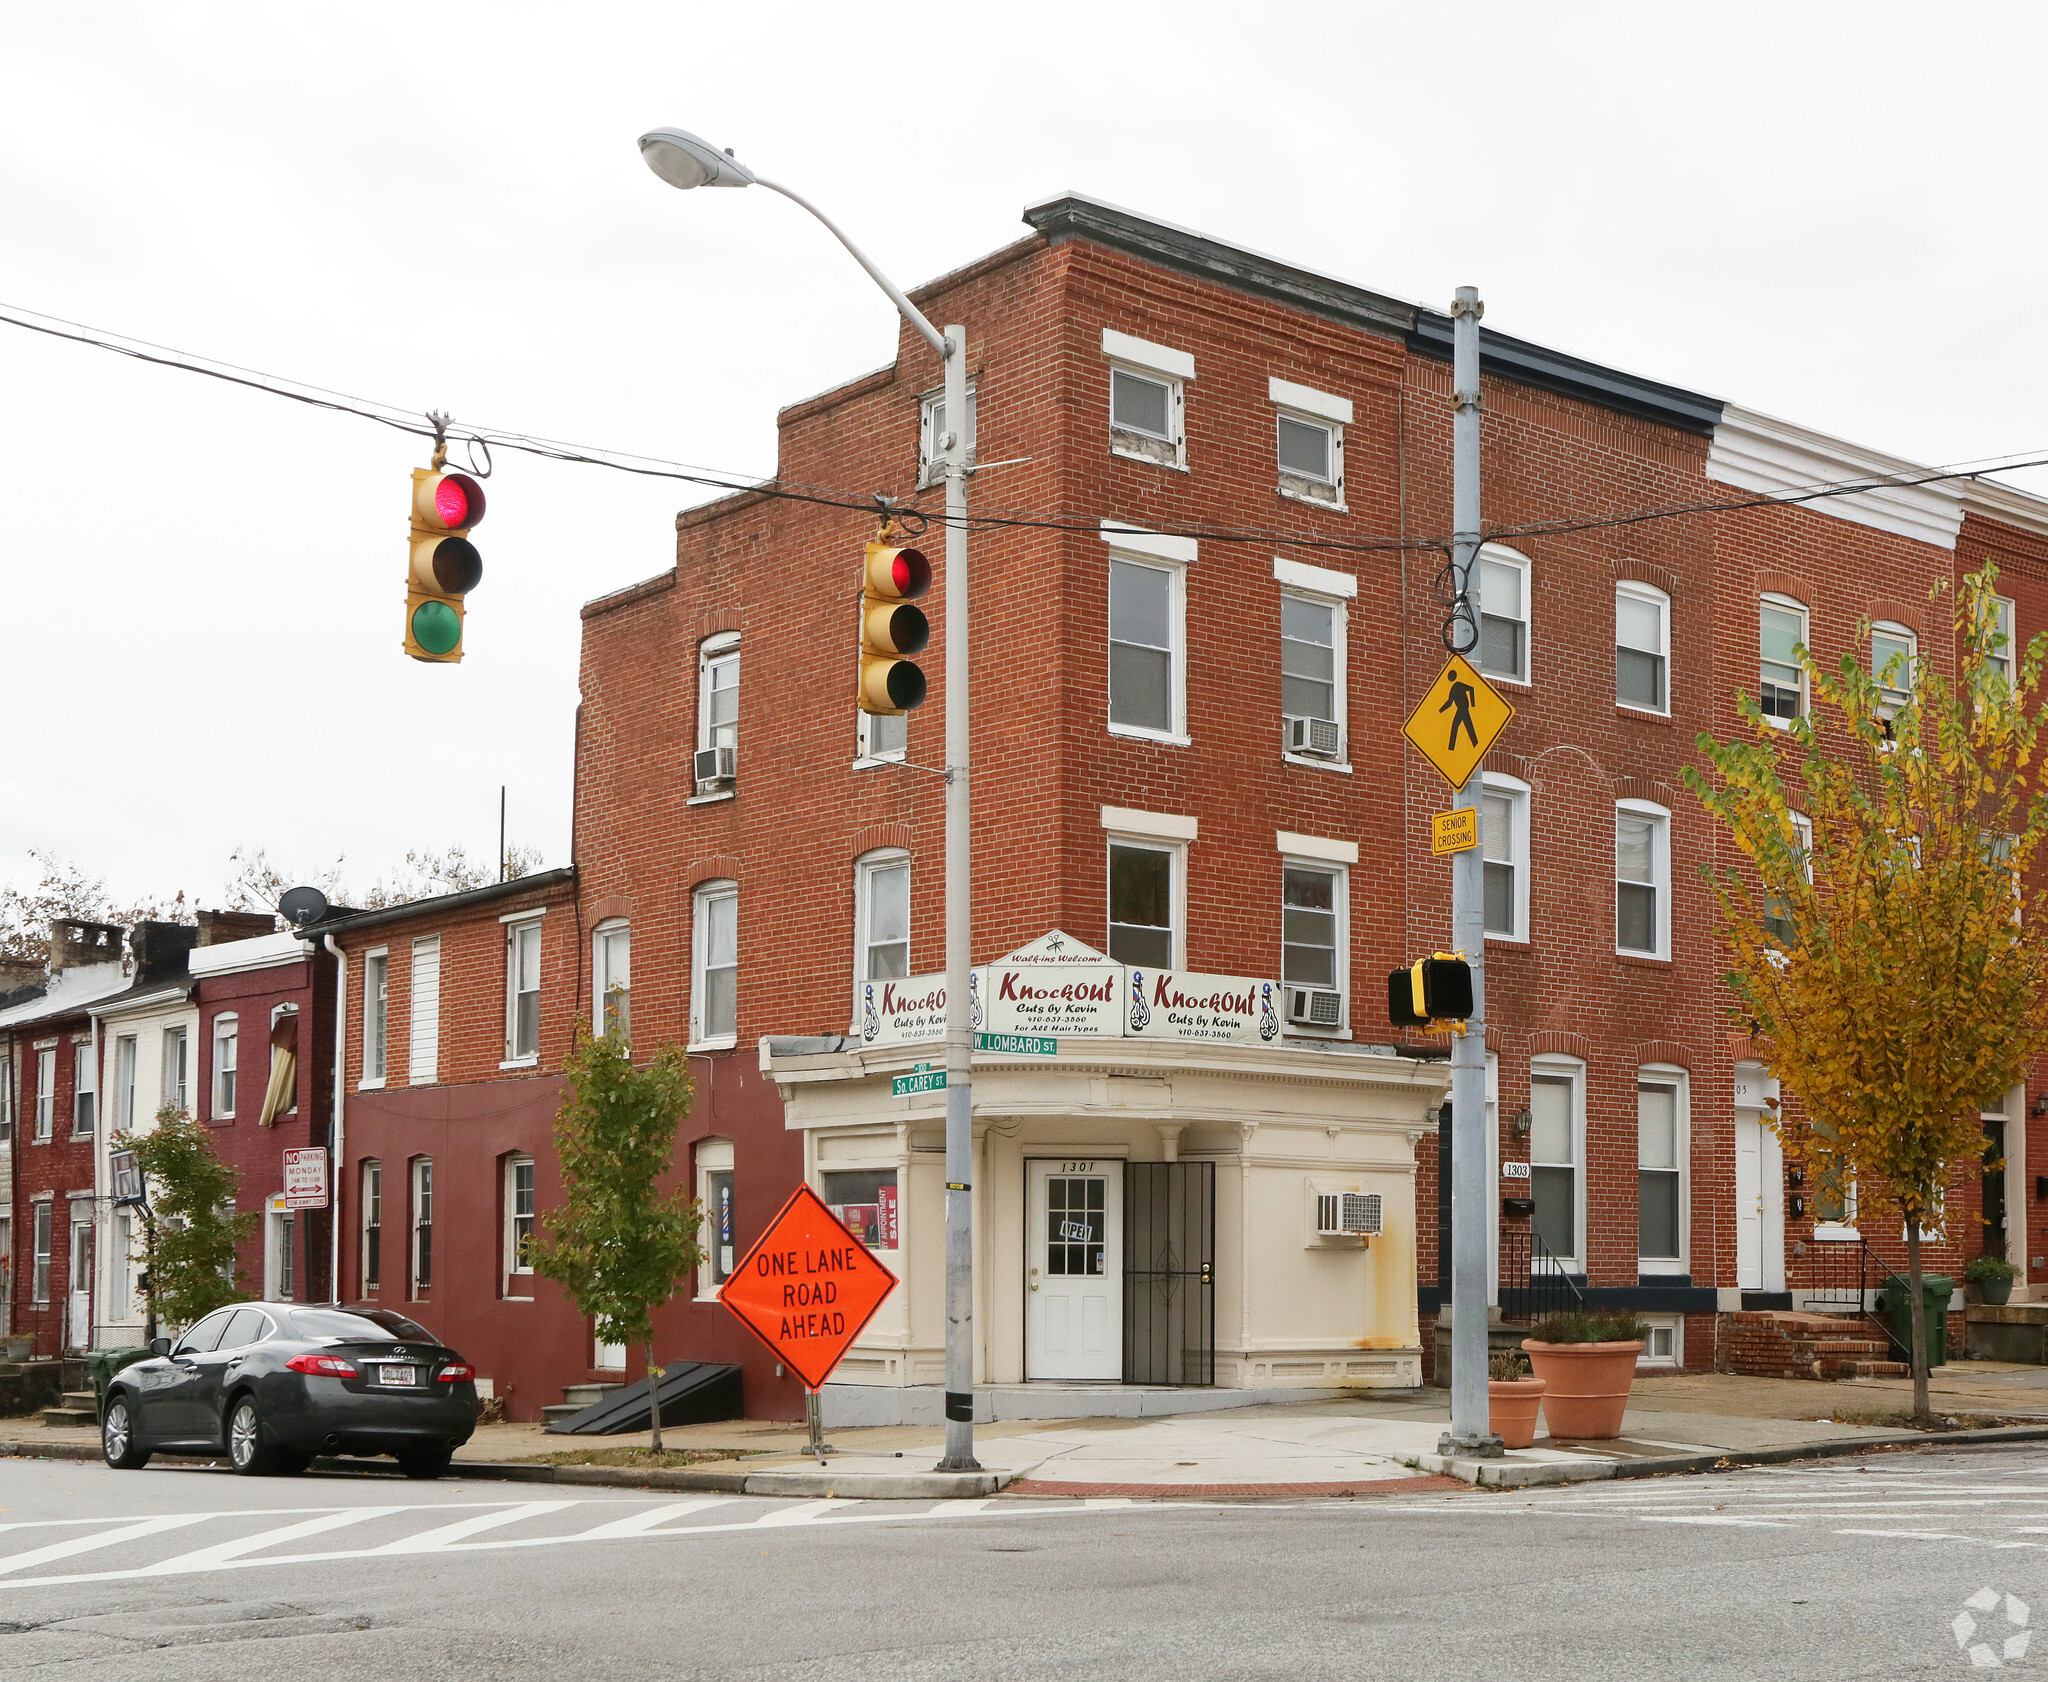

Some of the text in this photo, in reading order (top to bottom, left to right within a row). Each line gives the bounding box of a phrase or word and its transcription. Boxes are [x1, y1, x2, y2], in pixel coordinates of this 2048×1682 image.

[1442, 816, 1467, 831] SENIOR
[1438, 831, 1472, 847] CROSSING
[1011, 954, 1102, 963] Walk-ins Welcome
[882, 982, 946, 1016] KnockO
[1016, 1003, 1098, 1014] Cuts by Kevin
[894, 1014, 946, 1029] Cuts by Kevi
[1074, 1025, 1099, 1033] Types
[1168, 1013, 1241, 1029] Cuts by Kevin
[974, 1033, 1056, 1053] W. LOMBARD ST.
[908, 1074, 934, 1092] CAREY
[286, 1151, 324, 1164] NO PARKING
[289, 1166, 322, 1175] MONDAY
[1062, 1162, 1094, 1173] 1301
[1507, 1164, 1528, 1177] 1303
[878, 1189, 888, 1240] APPOINTMENT
[888, 1199, 898, 1240] SALE
[757, 1247, 857, 1277] ONE LANE
[783, 1281, 837, 1307] ROAD
[780, 1312, 845, 1340] AHEAD
